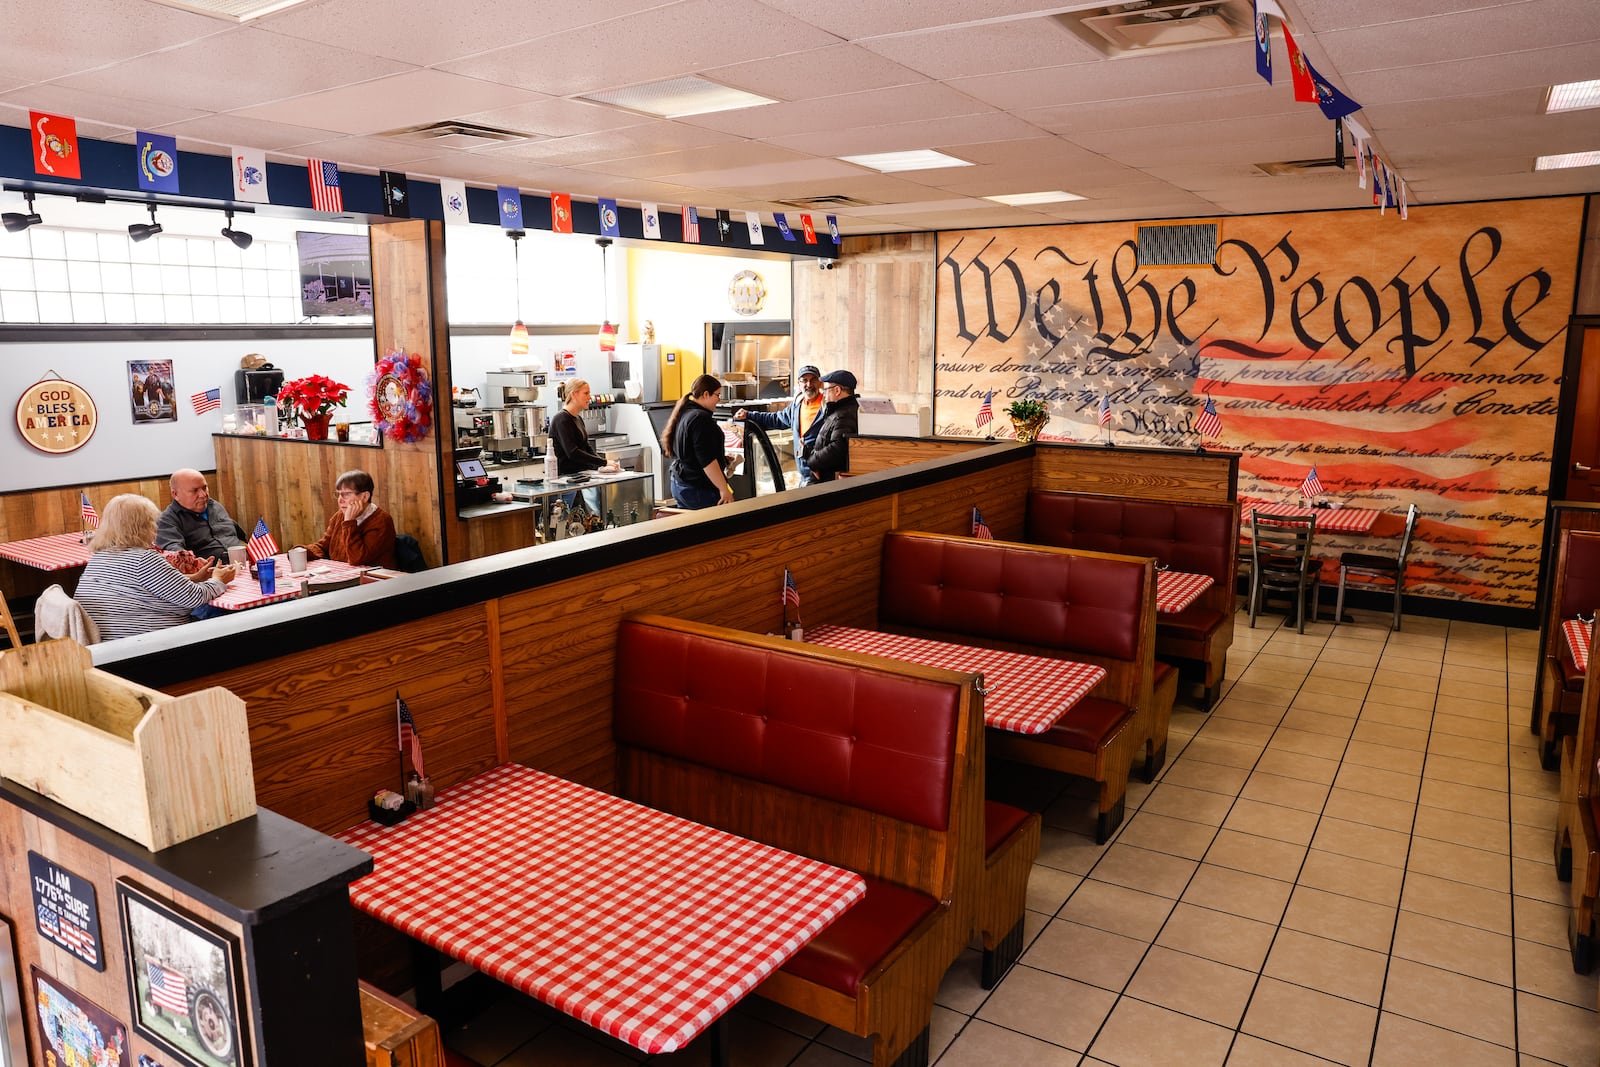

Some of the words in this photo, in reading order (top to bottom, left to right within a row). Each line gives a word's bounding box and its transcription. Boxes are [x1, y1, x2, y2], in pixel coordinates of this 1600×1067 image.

[937, 236, 1083, 359] We
[1080, 239, 1220, 361] the
[1194, 226, 1569, 378] People
[935, 353, 986, 373] insure
[990, 357, 1078, 375] domestic
[1226, 361, 1329, 387] provide
[1320, 356, 1377, 394] for
[1420, 372, 1549, 385] common
[37, 402, 76, 414] BLESS
[40, 391, 70, 401] GOD
[934, 383, 973, 399] and
[1224, 393, 1283, 410] and
[1275, 390, 1389, 414] establish
[26, 414, 91, 430] AMERICA
[49, 867, 54, 882] I
[56, 870, 71, 893] AM
[34, 876, 64, 902] 1776%
[64, 893, 91, 922] SURE
[38, 904, 98, 965] GUNS
